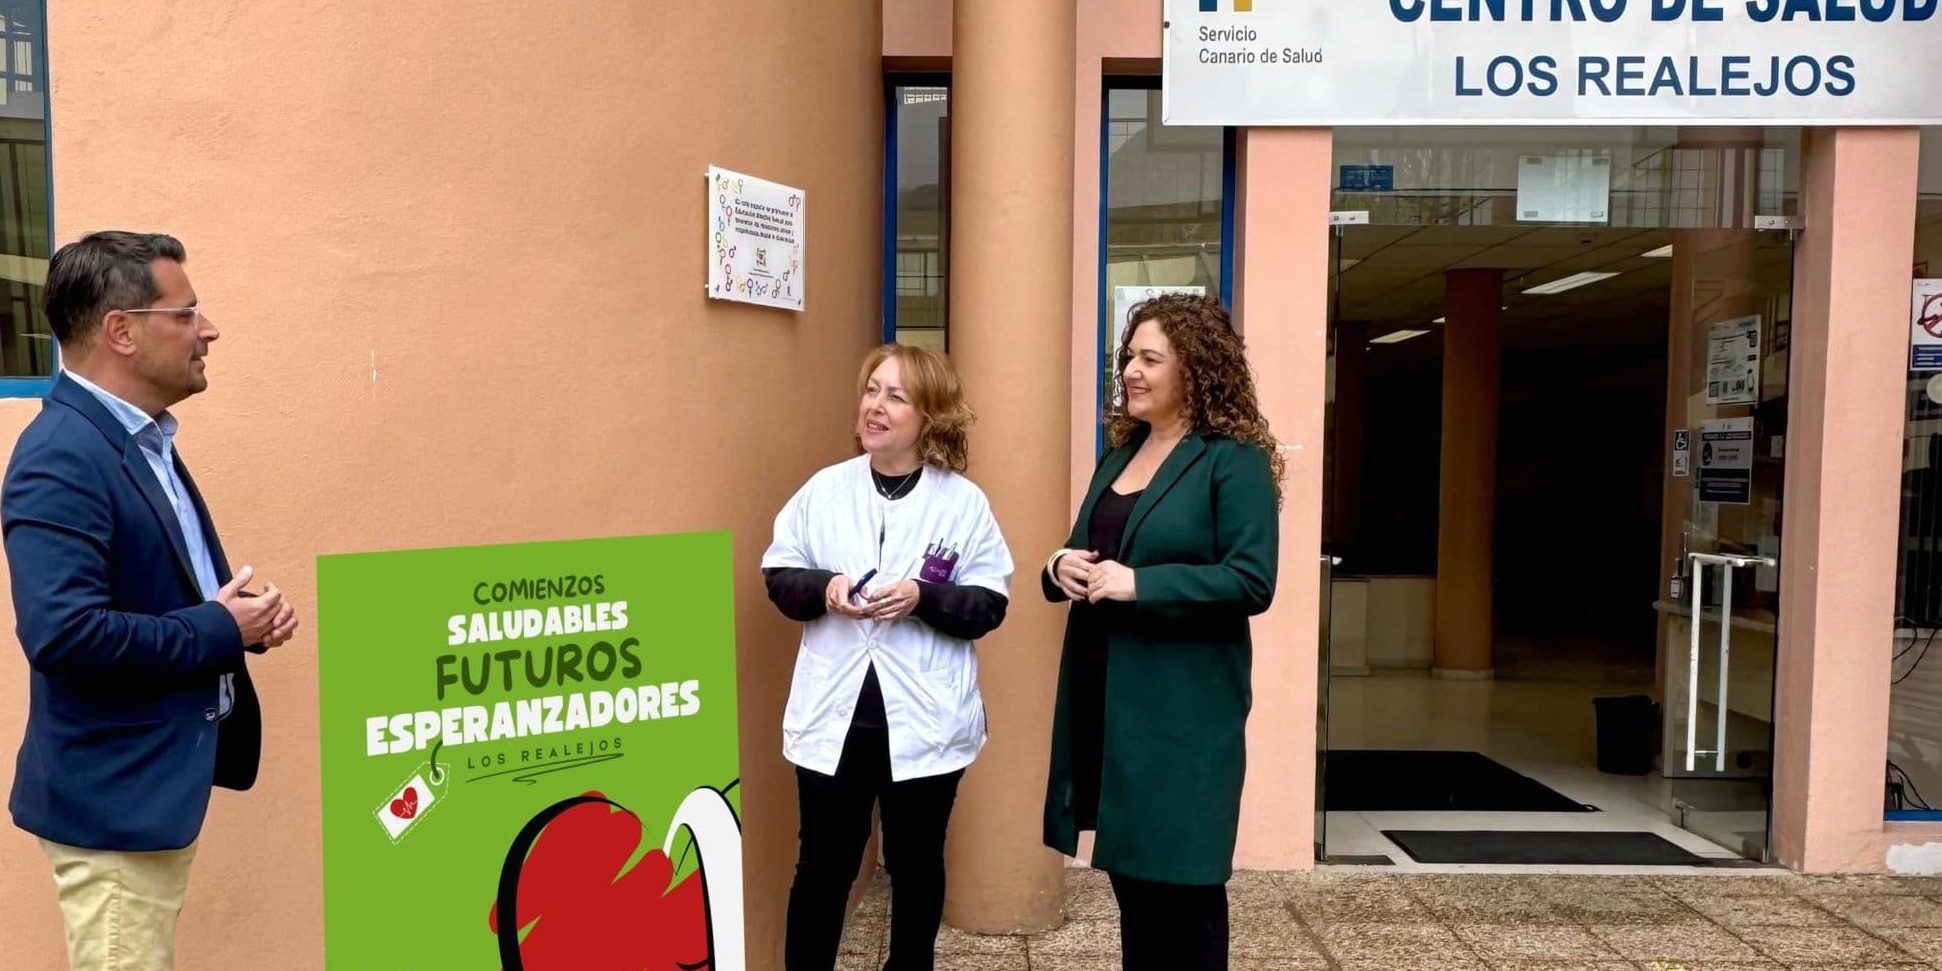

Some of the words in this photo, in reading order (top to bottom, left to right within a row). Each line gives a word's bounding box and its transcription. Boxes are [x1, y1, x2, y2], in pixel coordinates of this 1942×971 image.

[1198, 25, 1257, 42] Servicio
[1199, 47, 1255, 64] Canario
[1260, 48, 1278, 64] de
[1282, 48, 1323, 64] Salud
[1455, 55, 1558, 97] LOS
[1577, 55, 1856, 97] REALEJOS
[473, 574, 605, 605] COMIENZOS
[447, 600, 629, 646] SALUDABLES
[435, 637, 642, 701] FUTUROS
[366, 679, 701, 756] ESPERANZADORES
[467, 753, 505, 769] LOS
[521, 737, 622, 762] REALEJOS
